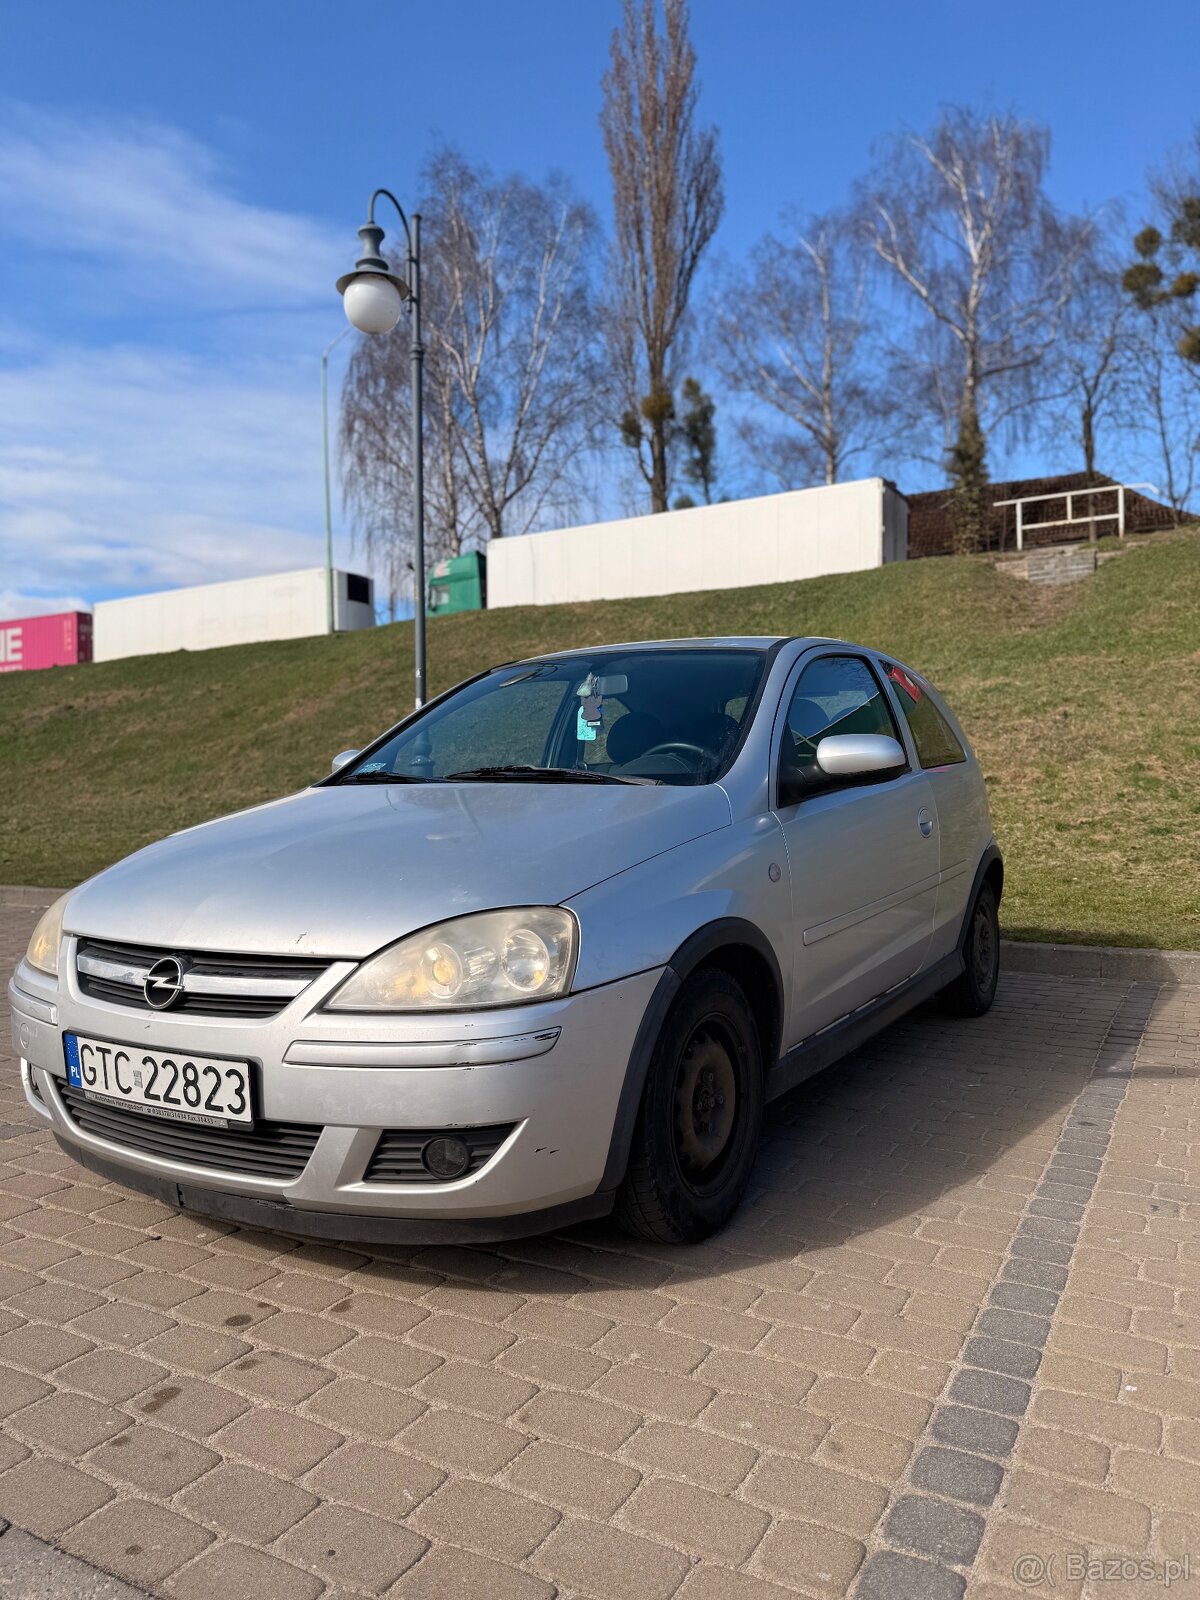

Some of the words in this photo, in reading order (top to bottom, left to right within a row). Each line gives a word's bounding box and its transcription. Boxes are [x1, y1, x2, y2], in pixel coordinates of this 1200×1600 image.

[70, 1065, 80, 1079] PL
[80, 1044, 133, 1095] GTC
[142, 1055, 247, 1115] 22823
